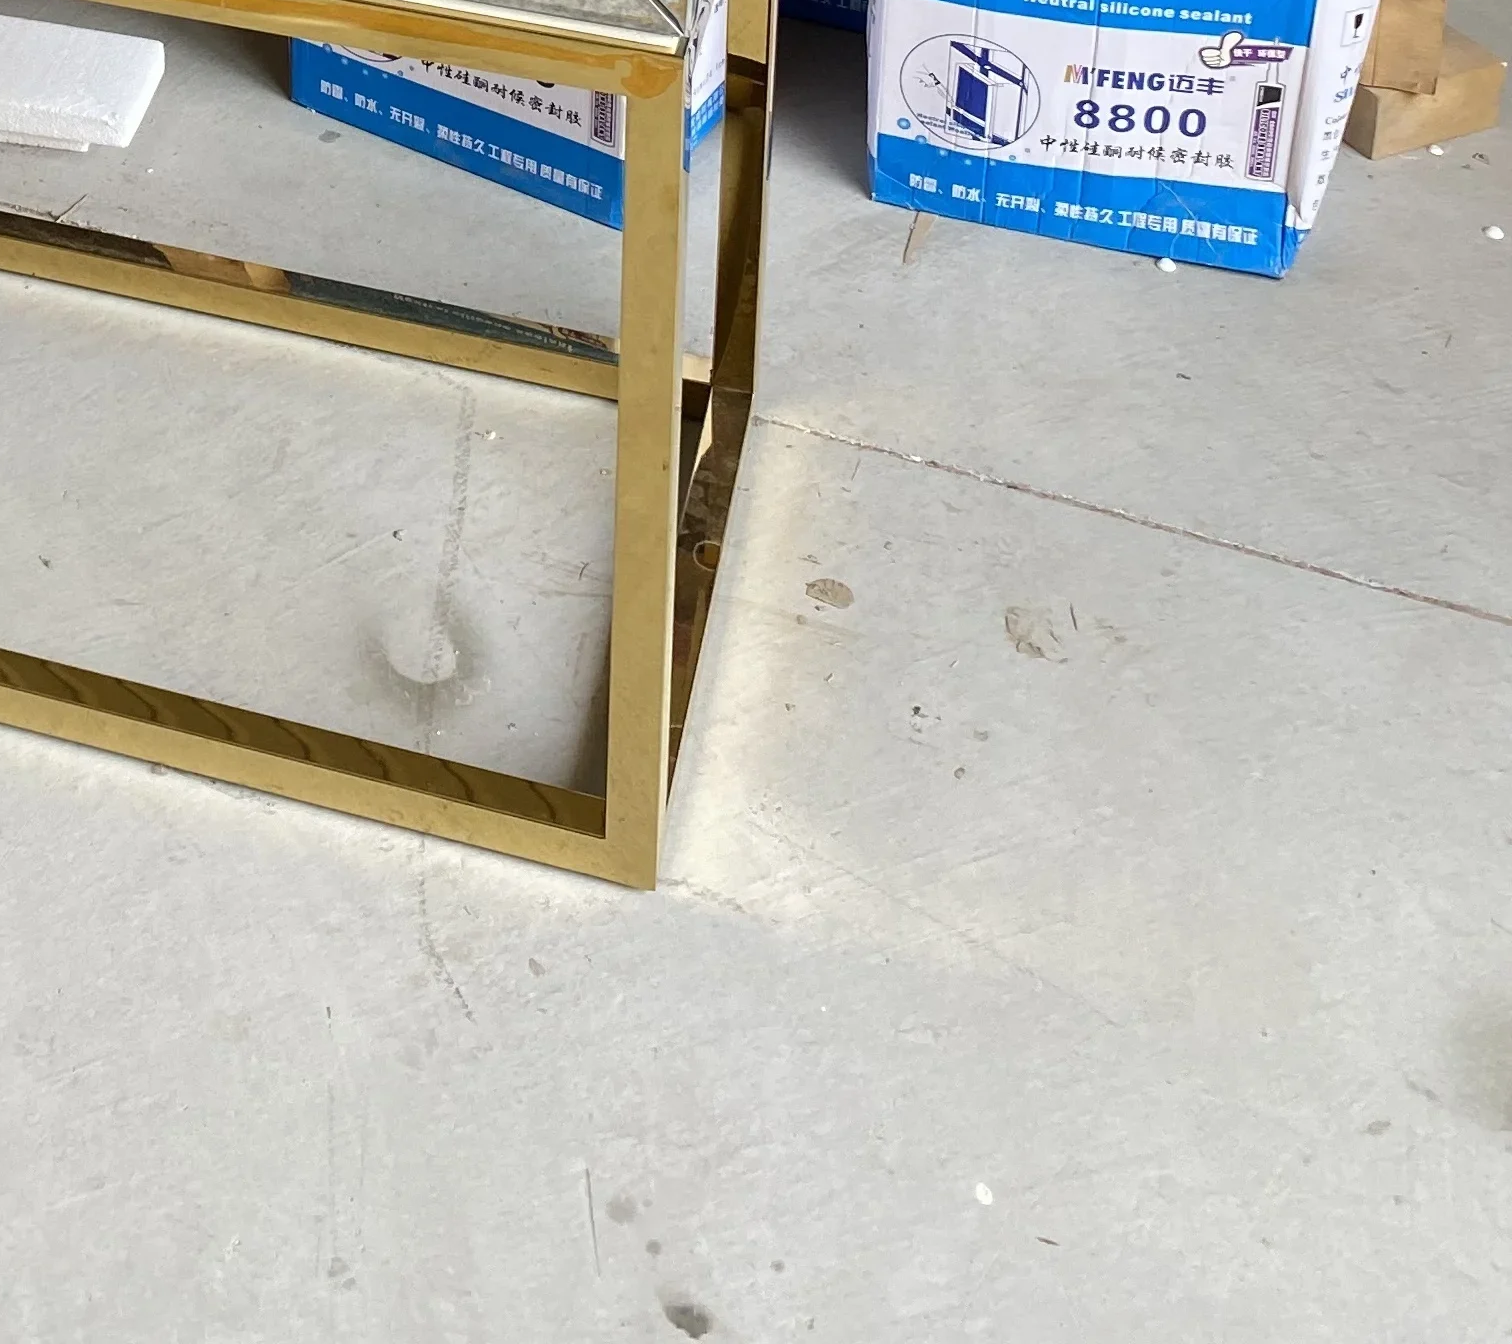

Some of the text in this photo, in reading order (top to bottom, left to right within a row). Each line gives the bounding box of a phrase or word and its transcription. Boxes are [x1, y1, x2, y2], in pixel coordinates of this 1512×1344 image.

[1100, 1, 1175, 19] silicone
[1179, 9, 1253, 25] sealant
[1073, 99, 1207, 138] 8800
[1039, 134, 1235, 170] 中性硅酮耐候密封胶
